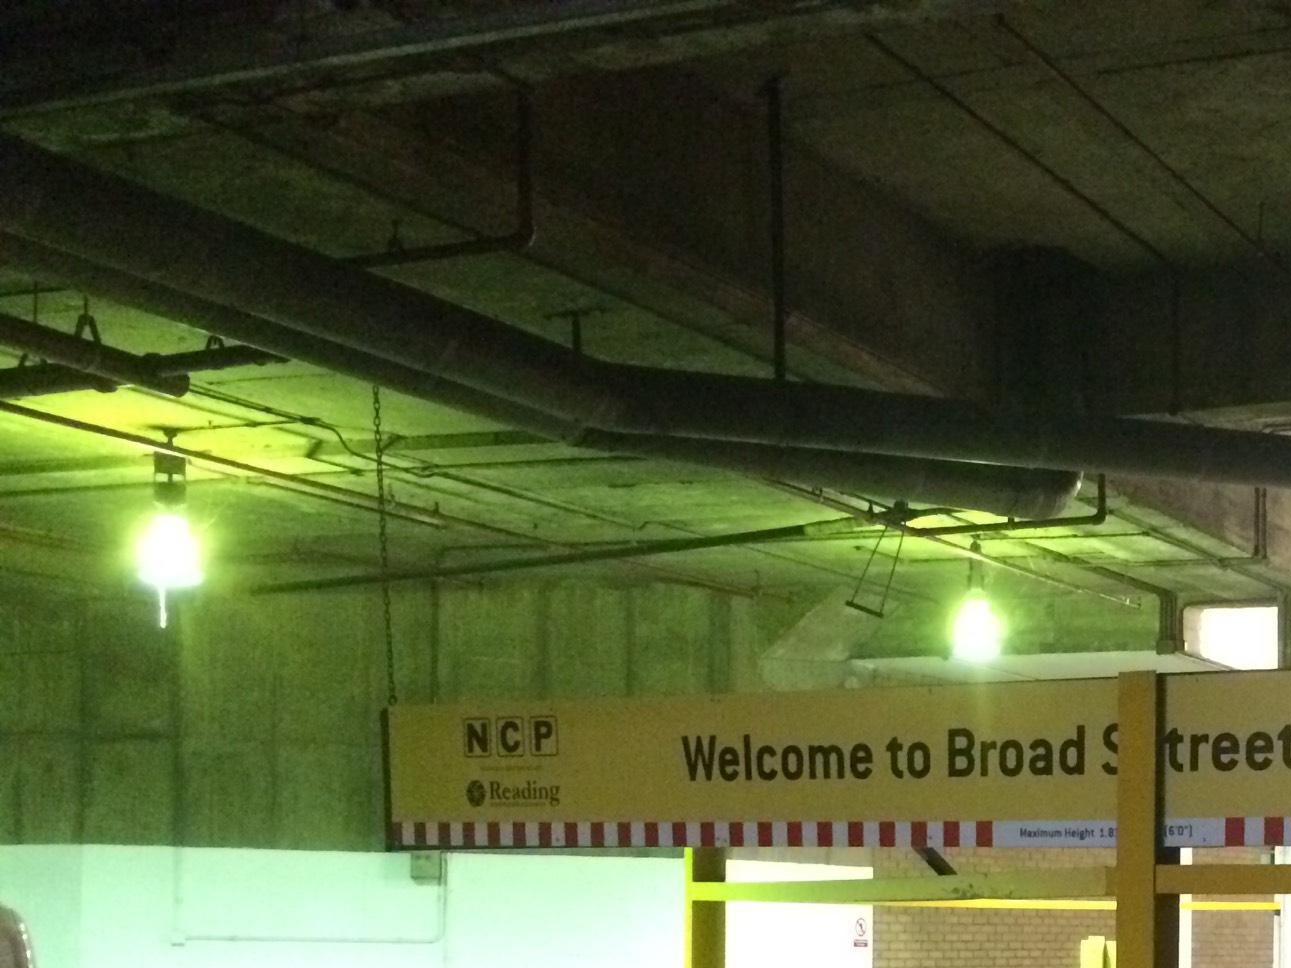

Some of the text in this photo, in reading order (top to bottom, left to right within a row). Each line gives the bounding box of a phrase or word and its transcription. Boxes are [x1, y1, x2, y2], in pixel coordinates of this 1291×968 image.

[466, 720, 553, 754] NCP
[681, 734, 873, 782] Welcome
[886, 737, 931, 778] to
[947, 725, 1086, 778] Broad
[490, 780, 560, 807] Reading
[1019, 827, 1062, 839] Maximum
[1064, 826, 1095, 841] Height
